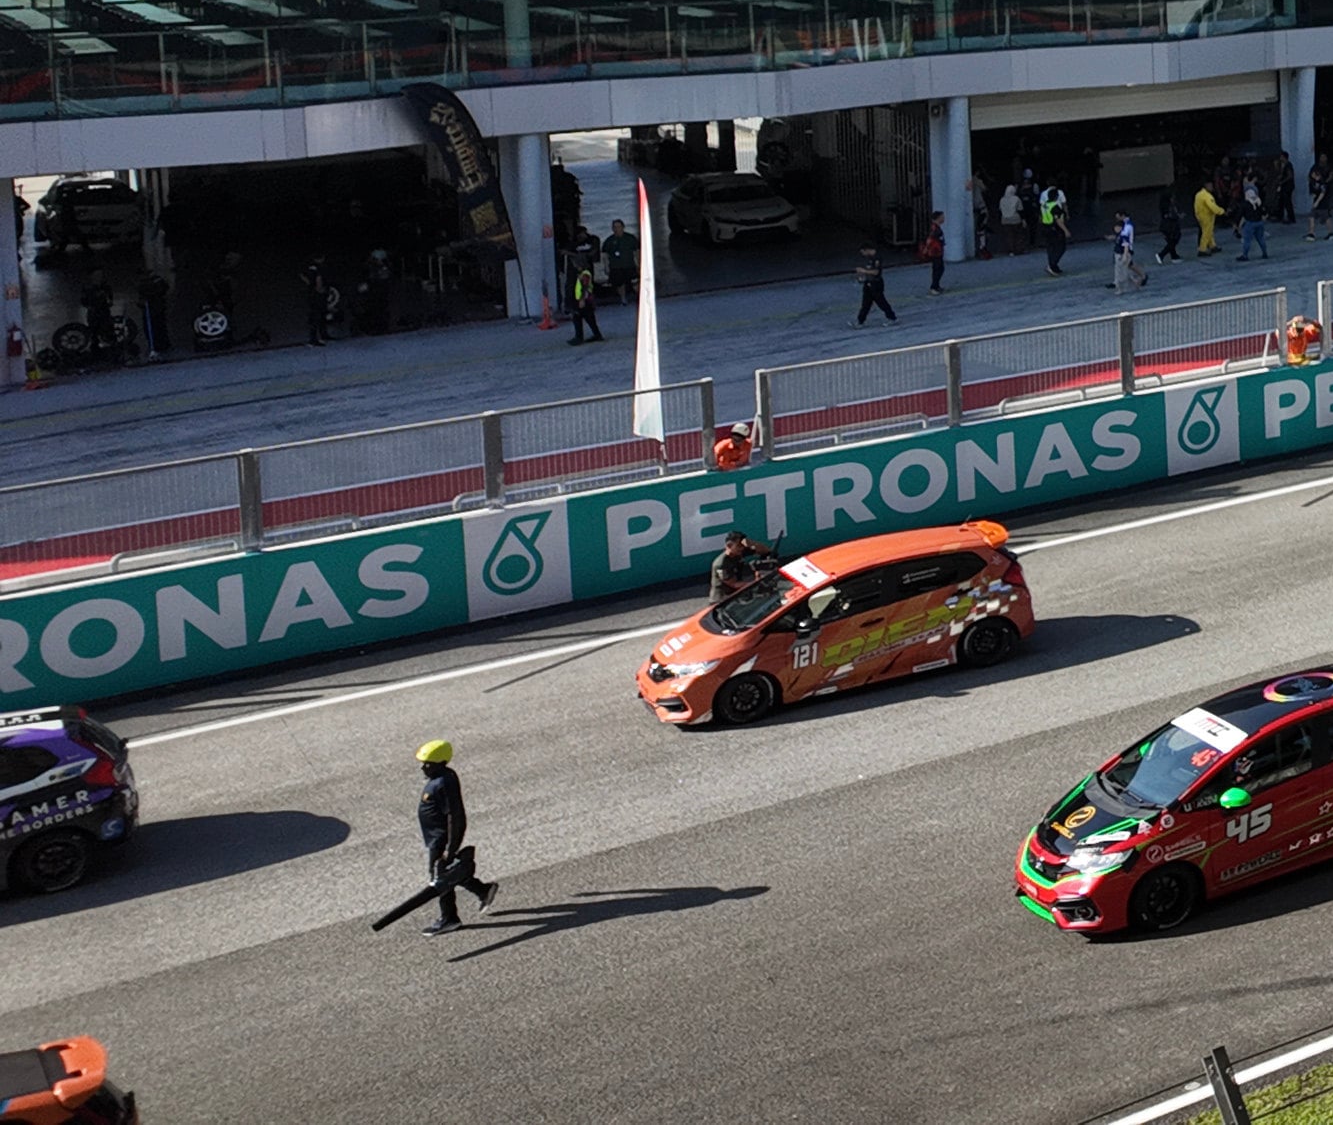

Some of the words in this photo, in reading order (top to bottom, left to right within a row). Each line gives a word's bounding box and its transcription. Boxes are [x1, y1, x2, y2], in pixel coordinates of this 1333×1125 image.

[605, 410, 1142, 572] PETRONAS
[792, 641, 819, 670] 121
[0, 789, 90, 829] AMER
[1226, 802, 1273, 844] 45
